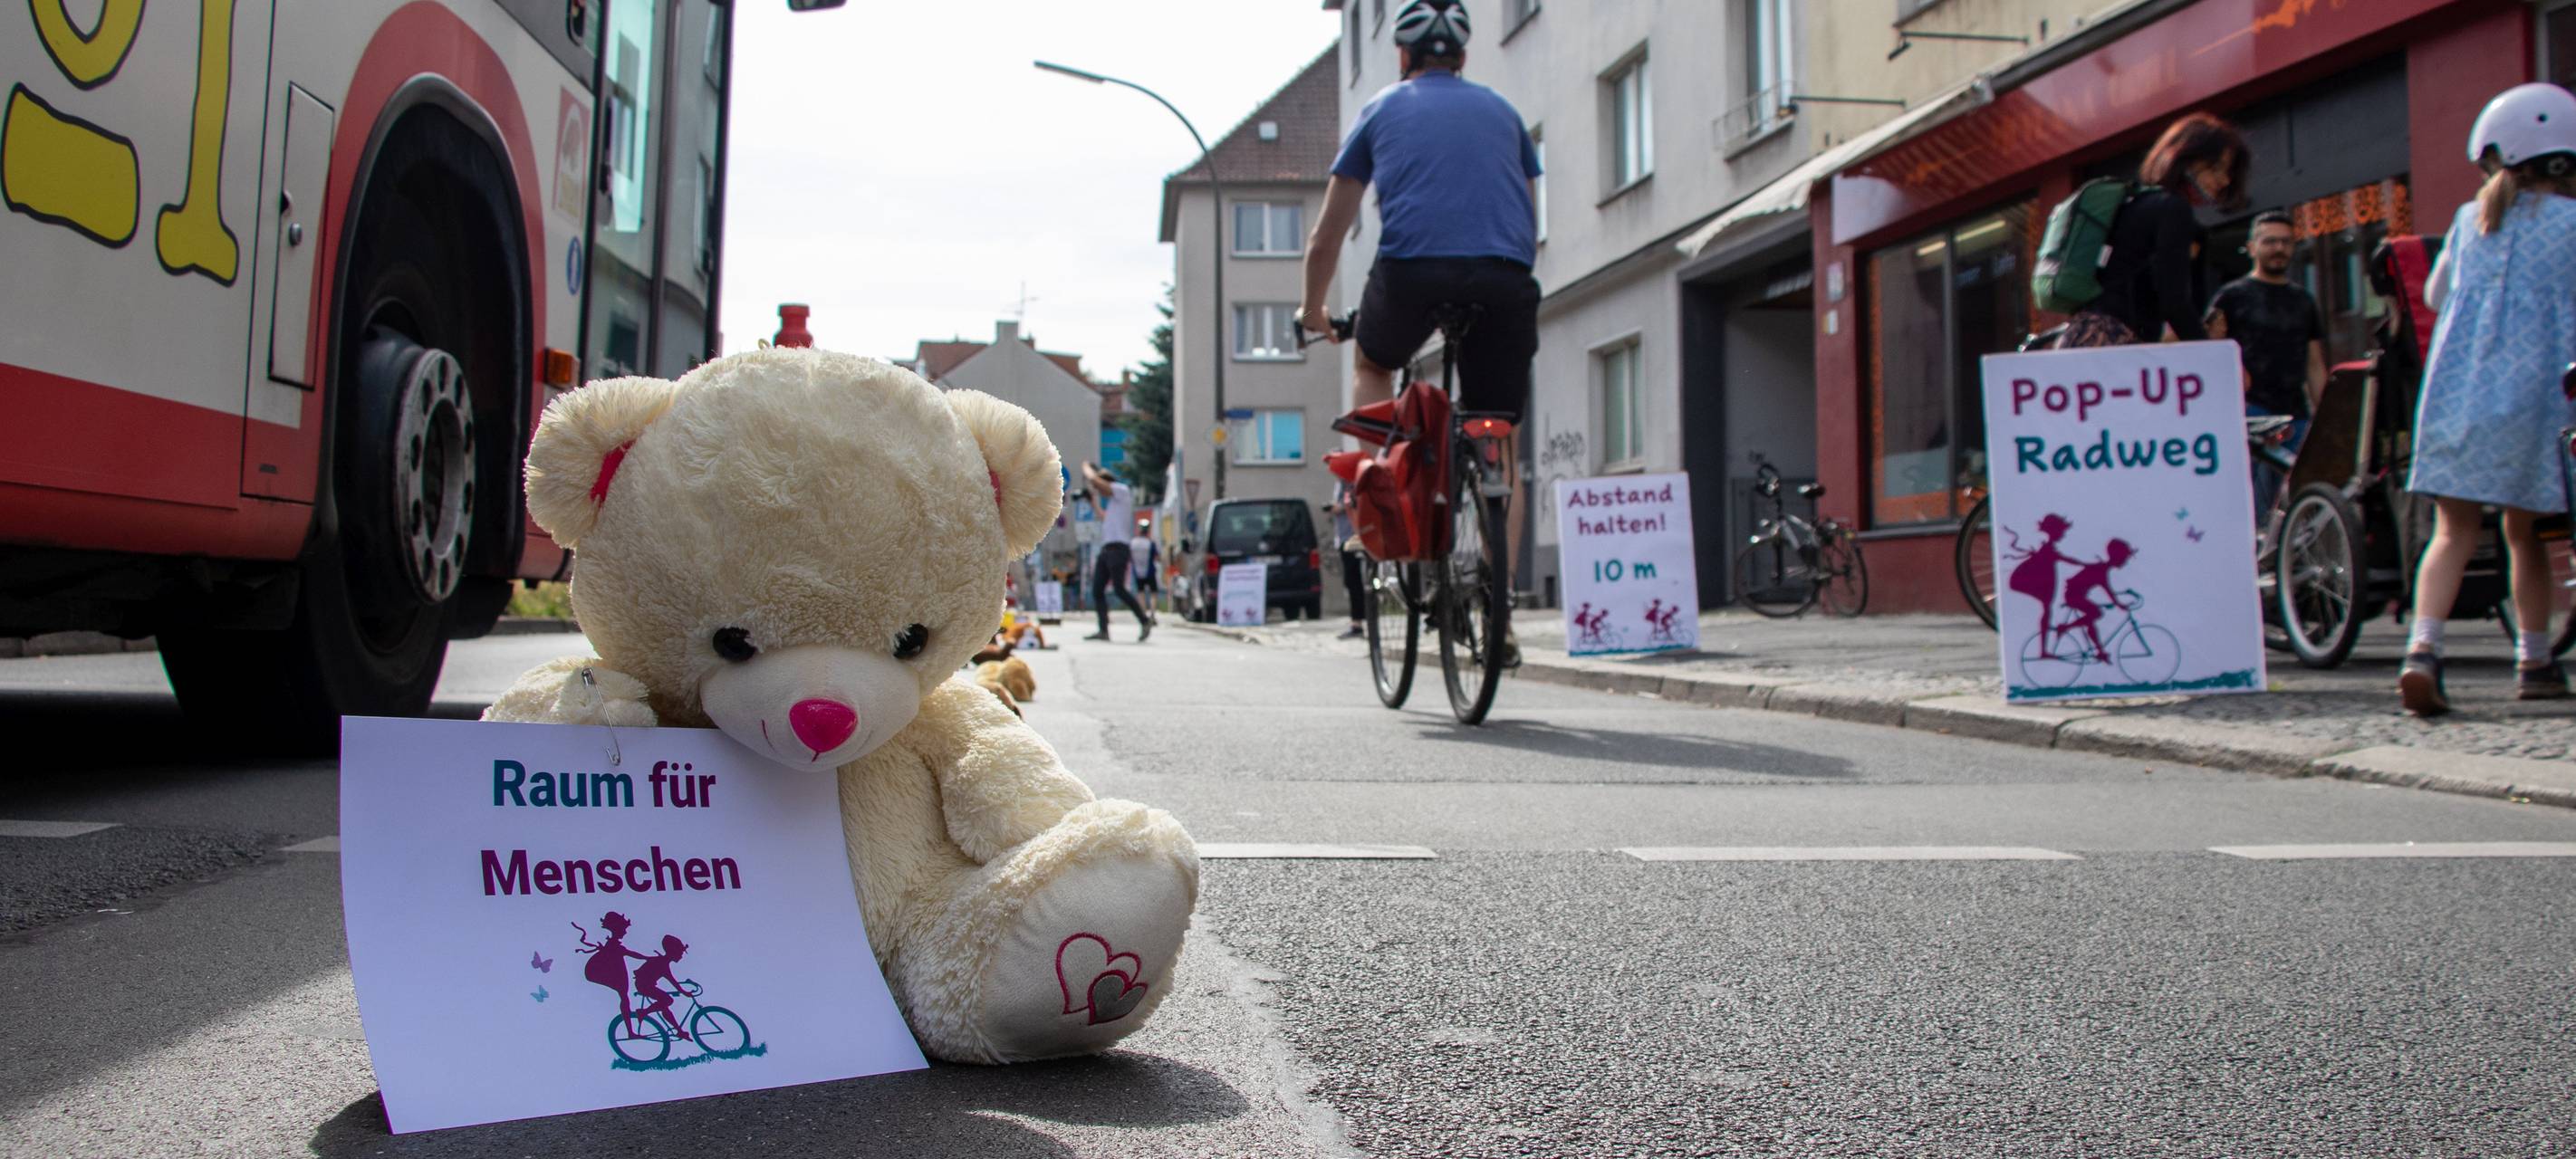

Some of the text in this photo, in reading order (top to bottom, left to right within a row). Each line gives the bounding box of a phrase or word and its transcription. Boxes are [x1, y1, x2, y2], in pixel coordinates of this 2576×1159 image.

[2011, 367, 2204, 422] Pop-Up
[2014, 429, 2219, 475] Radweg
[1568, 484, 1674, 508] Abstand
[1578, 513, 1667, 535] halten!
[1593, 558, 1658, 584] 10 m
[493, 758, 717, 809] Raum für
[480, 846, 742, 896] Menschen
